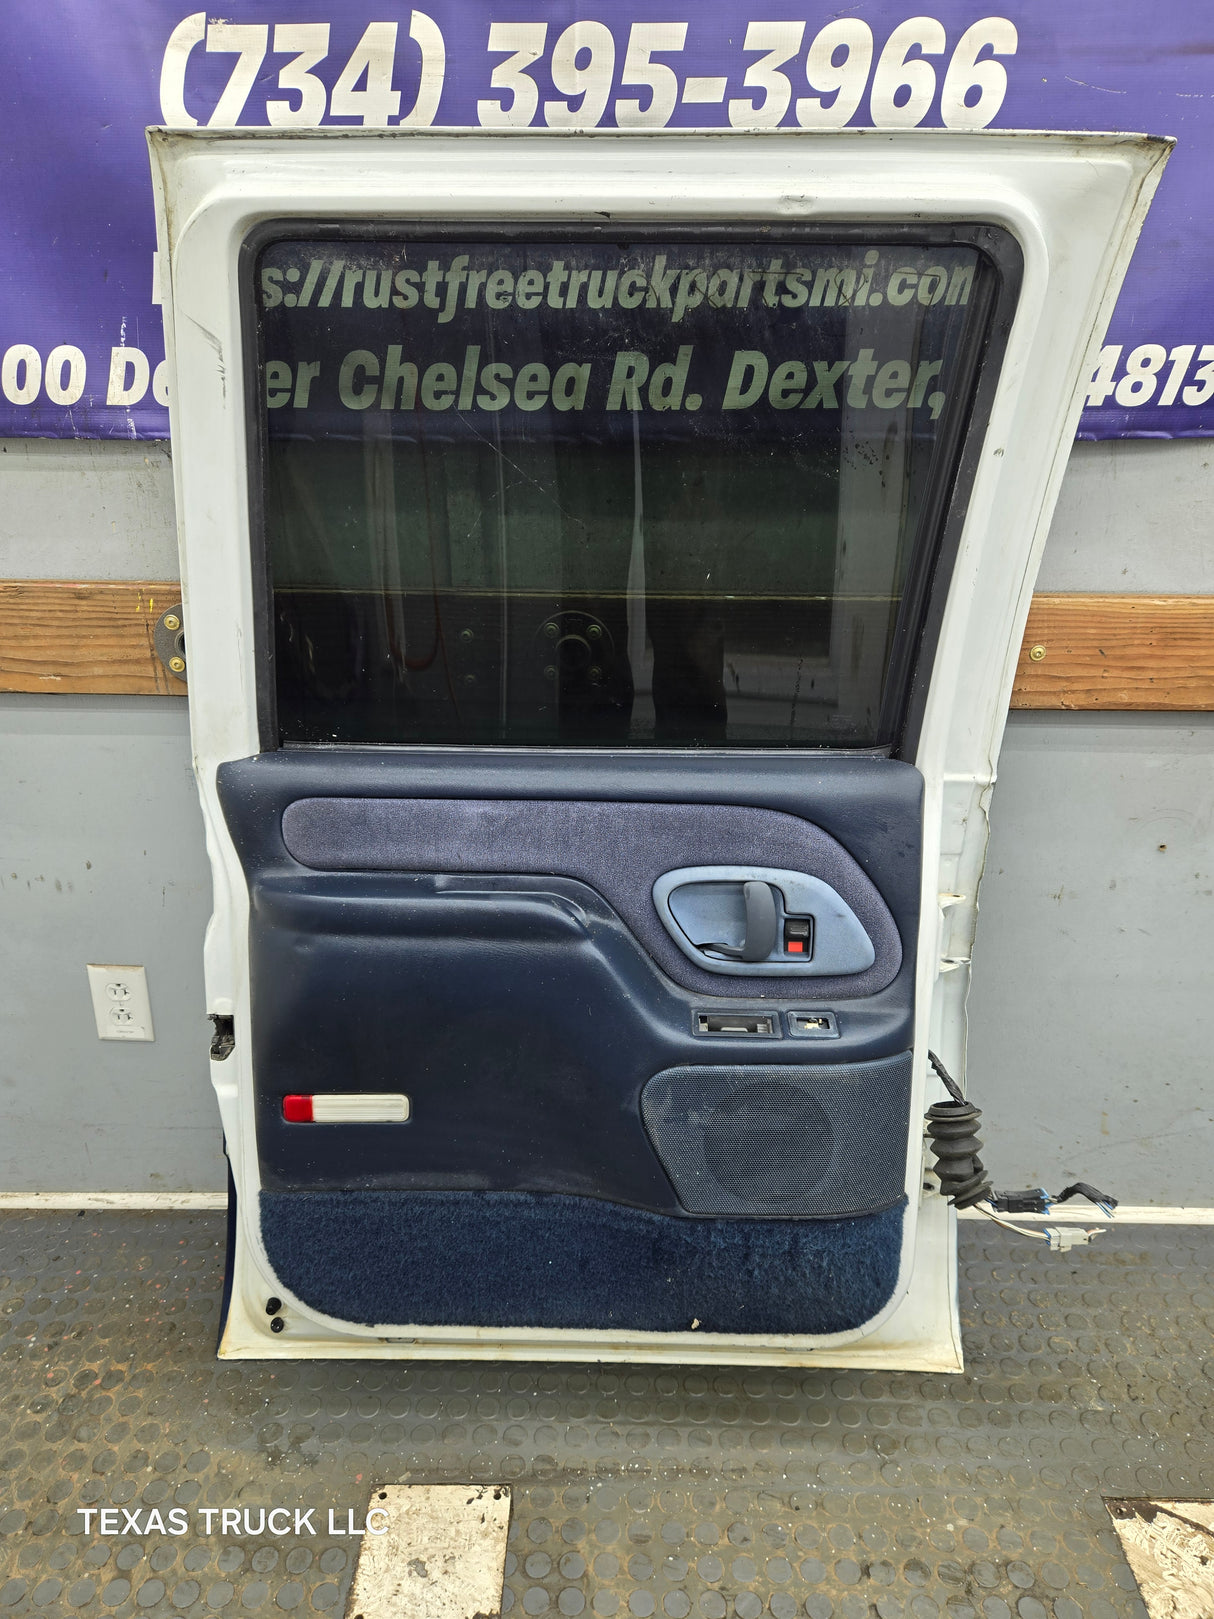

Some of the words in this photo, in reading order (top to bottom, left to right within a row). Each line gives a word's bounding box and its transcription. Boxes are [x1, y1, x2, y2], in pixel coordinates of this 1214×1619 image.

[160, 9, 446, 126] (734)
[477, 17, 1018, 128] 395-3966
[1, 344, 87, 406] 00
[339, 345, 591, 411] Chelsea
[605, 345, 703, 411] Rd.
[722, 348, 946, 420] Dexter,
